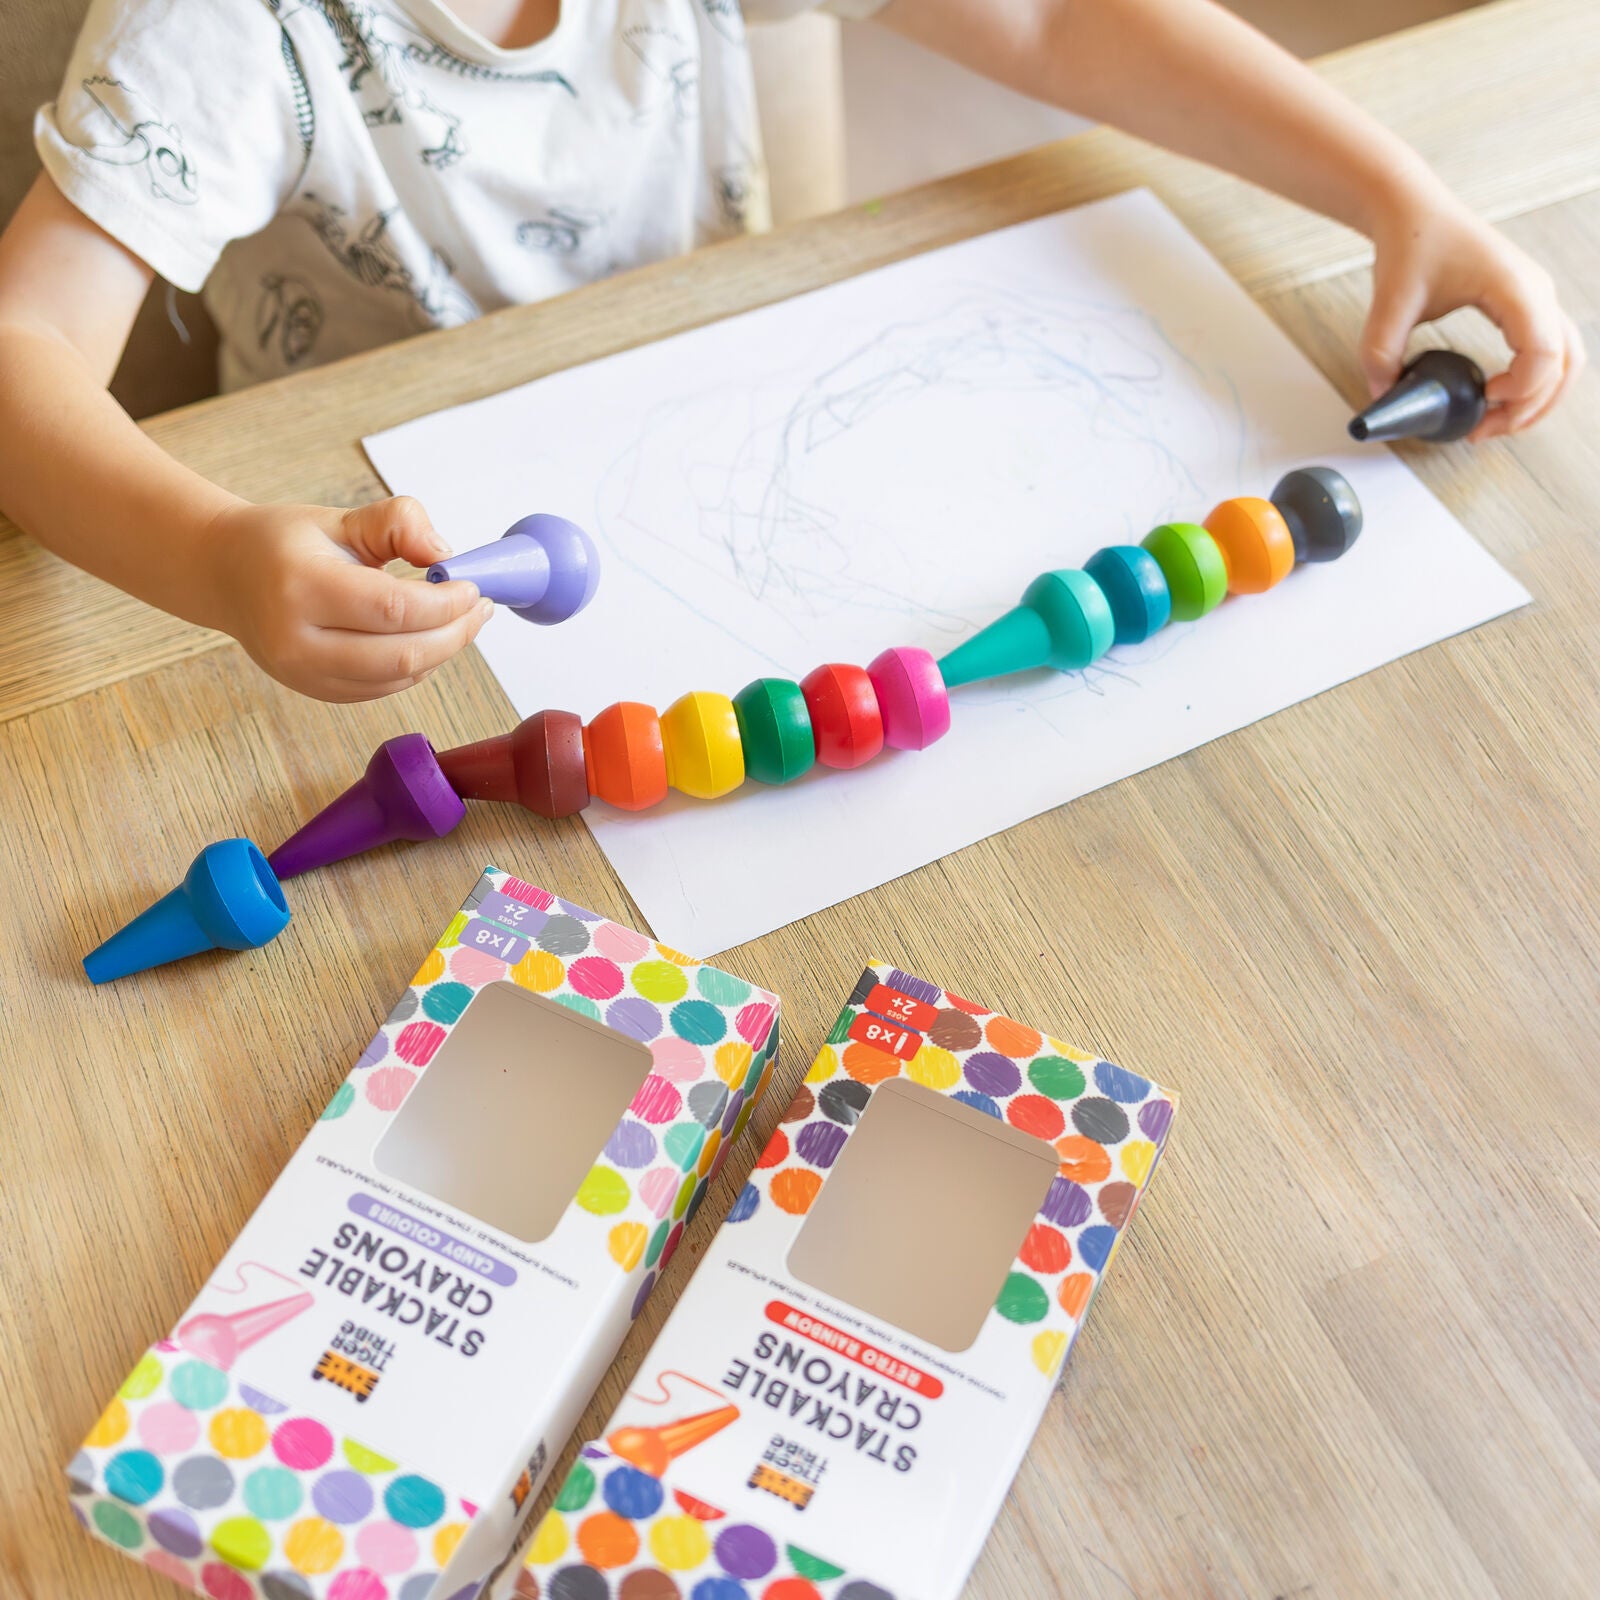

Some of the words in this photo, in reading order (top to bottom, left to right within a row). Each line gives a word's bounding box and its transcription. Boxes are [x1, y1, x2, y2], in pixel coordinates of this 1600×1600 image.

[498, 916, 518, 926] AGES
[504, 904, 528, 920] 2+
[887, 1010, 908, 1021] AGES
[892, 998, 917, 1015] 2+
[368, 1204, 440, 1246] COLOURS
[334, 1223, 492, 1315] CRAYONS
[442, 1242, 494, 1273] CANDY
[300, 1249, 484, 1356] STACKABLE
[785, 1308, 865, 1357] RAINBOW
[755, 1333, 921, 1430] CRAYONS
[862, 1346, 926, 1387] RETRO
[723, 1360, 916, 1472] STACKABLE
